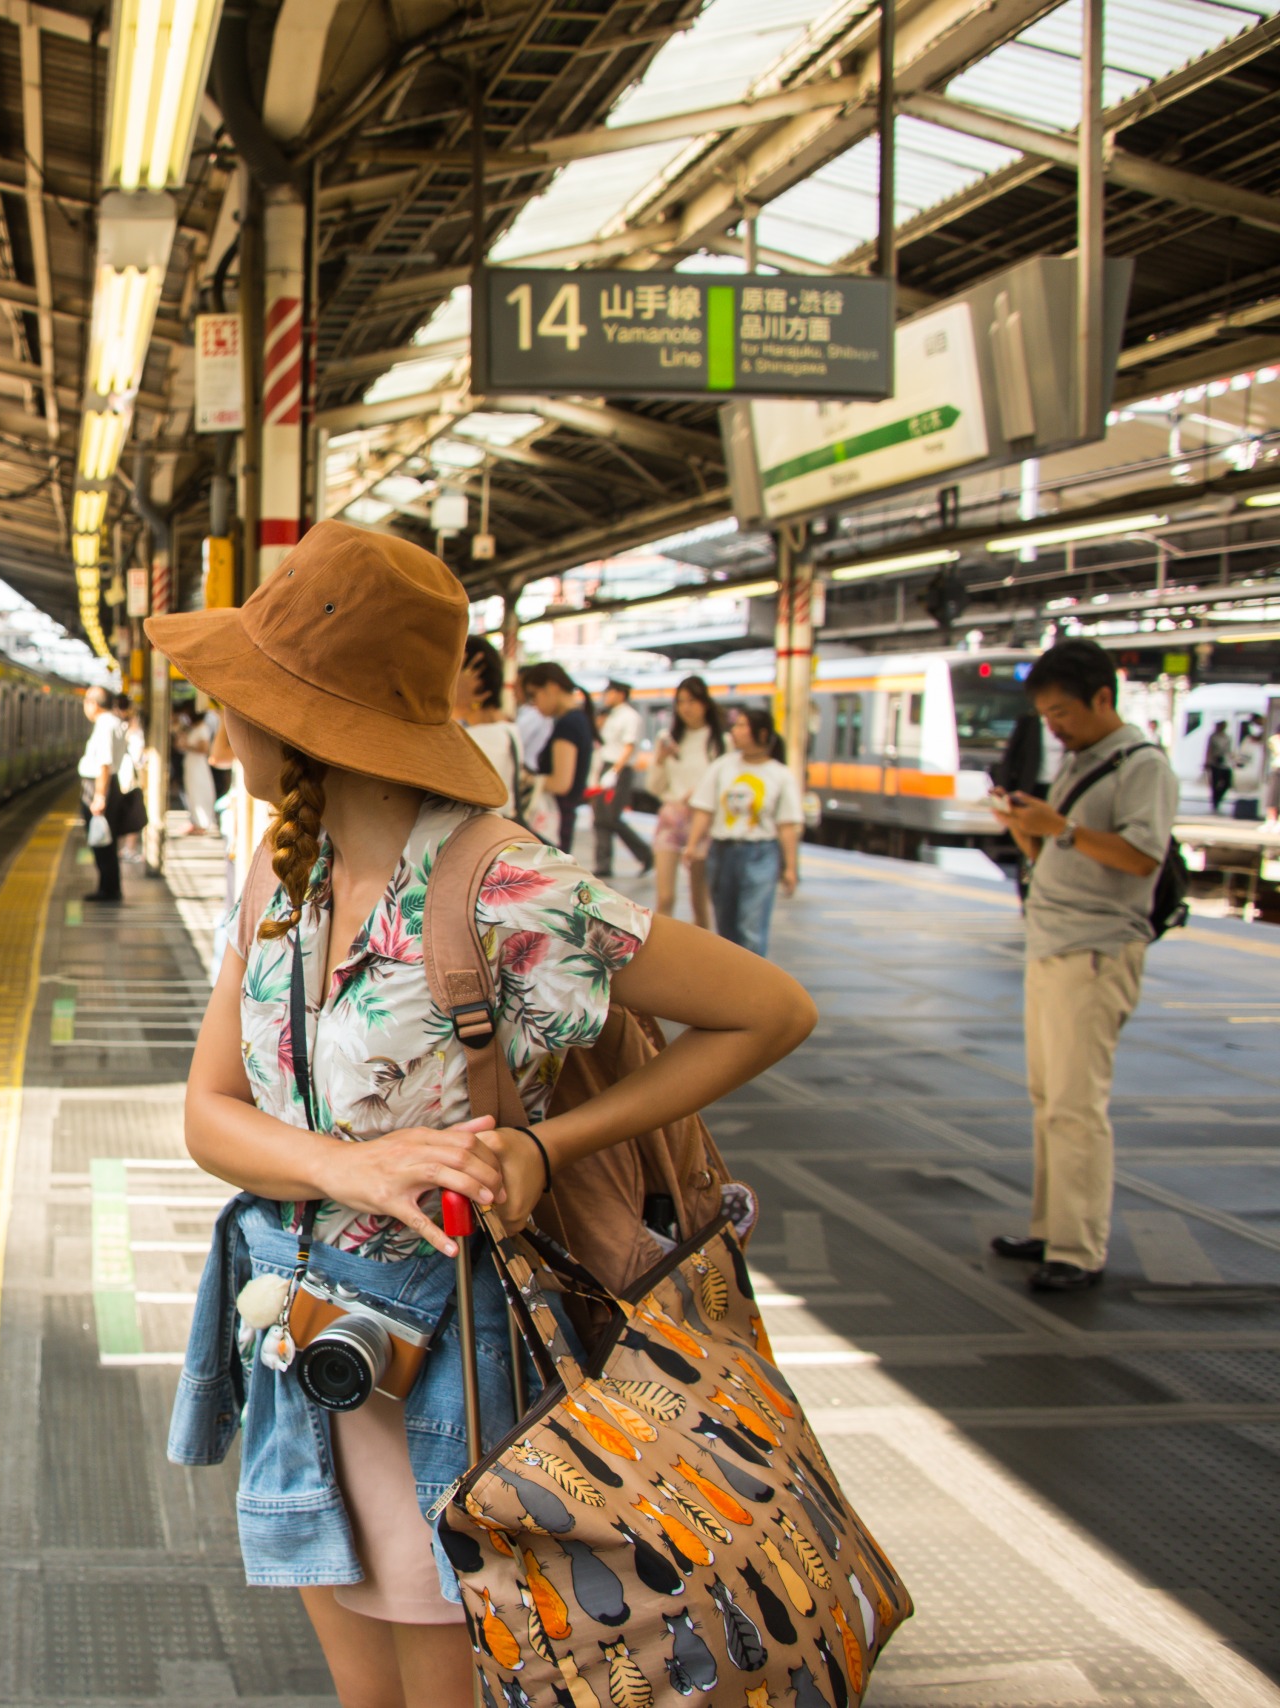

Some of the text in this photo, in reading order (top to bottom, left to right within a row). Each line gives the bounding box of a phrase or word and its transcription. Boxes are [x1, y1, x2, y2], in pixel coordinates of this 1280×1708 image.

[599, 284, 702, 320] 山手線
[741, 286, 844, 315] 原宿・渋谷
[506, 283, 588, 351] 14
[740, 314, 831, 342] 品川方面
[603, 322, 703, 344] Yamanote
[659, 347, 703, 368] Line
[740, 357, 753, 373] &
